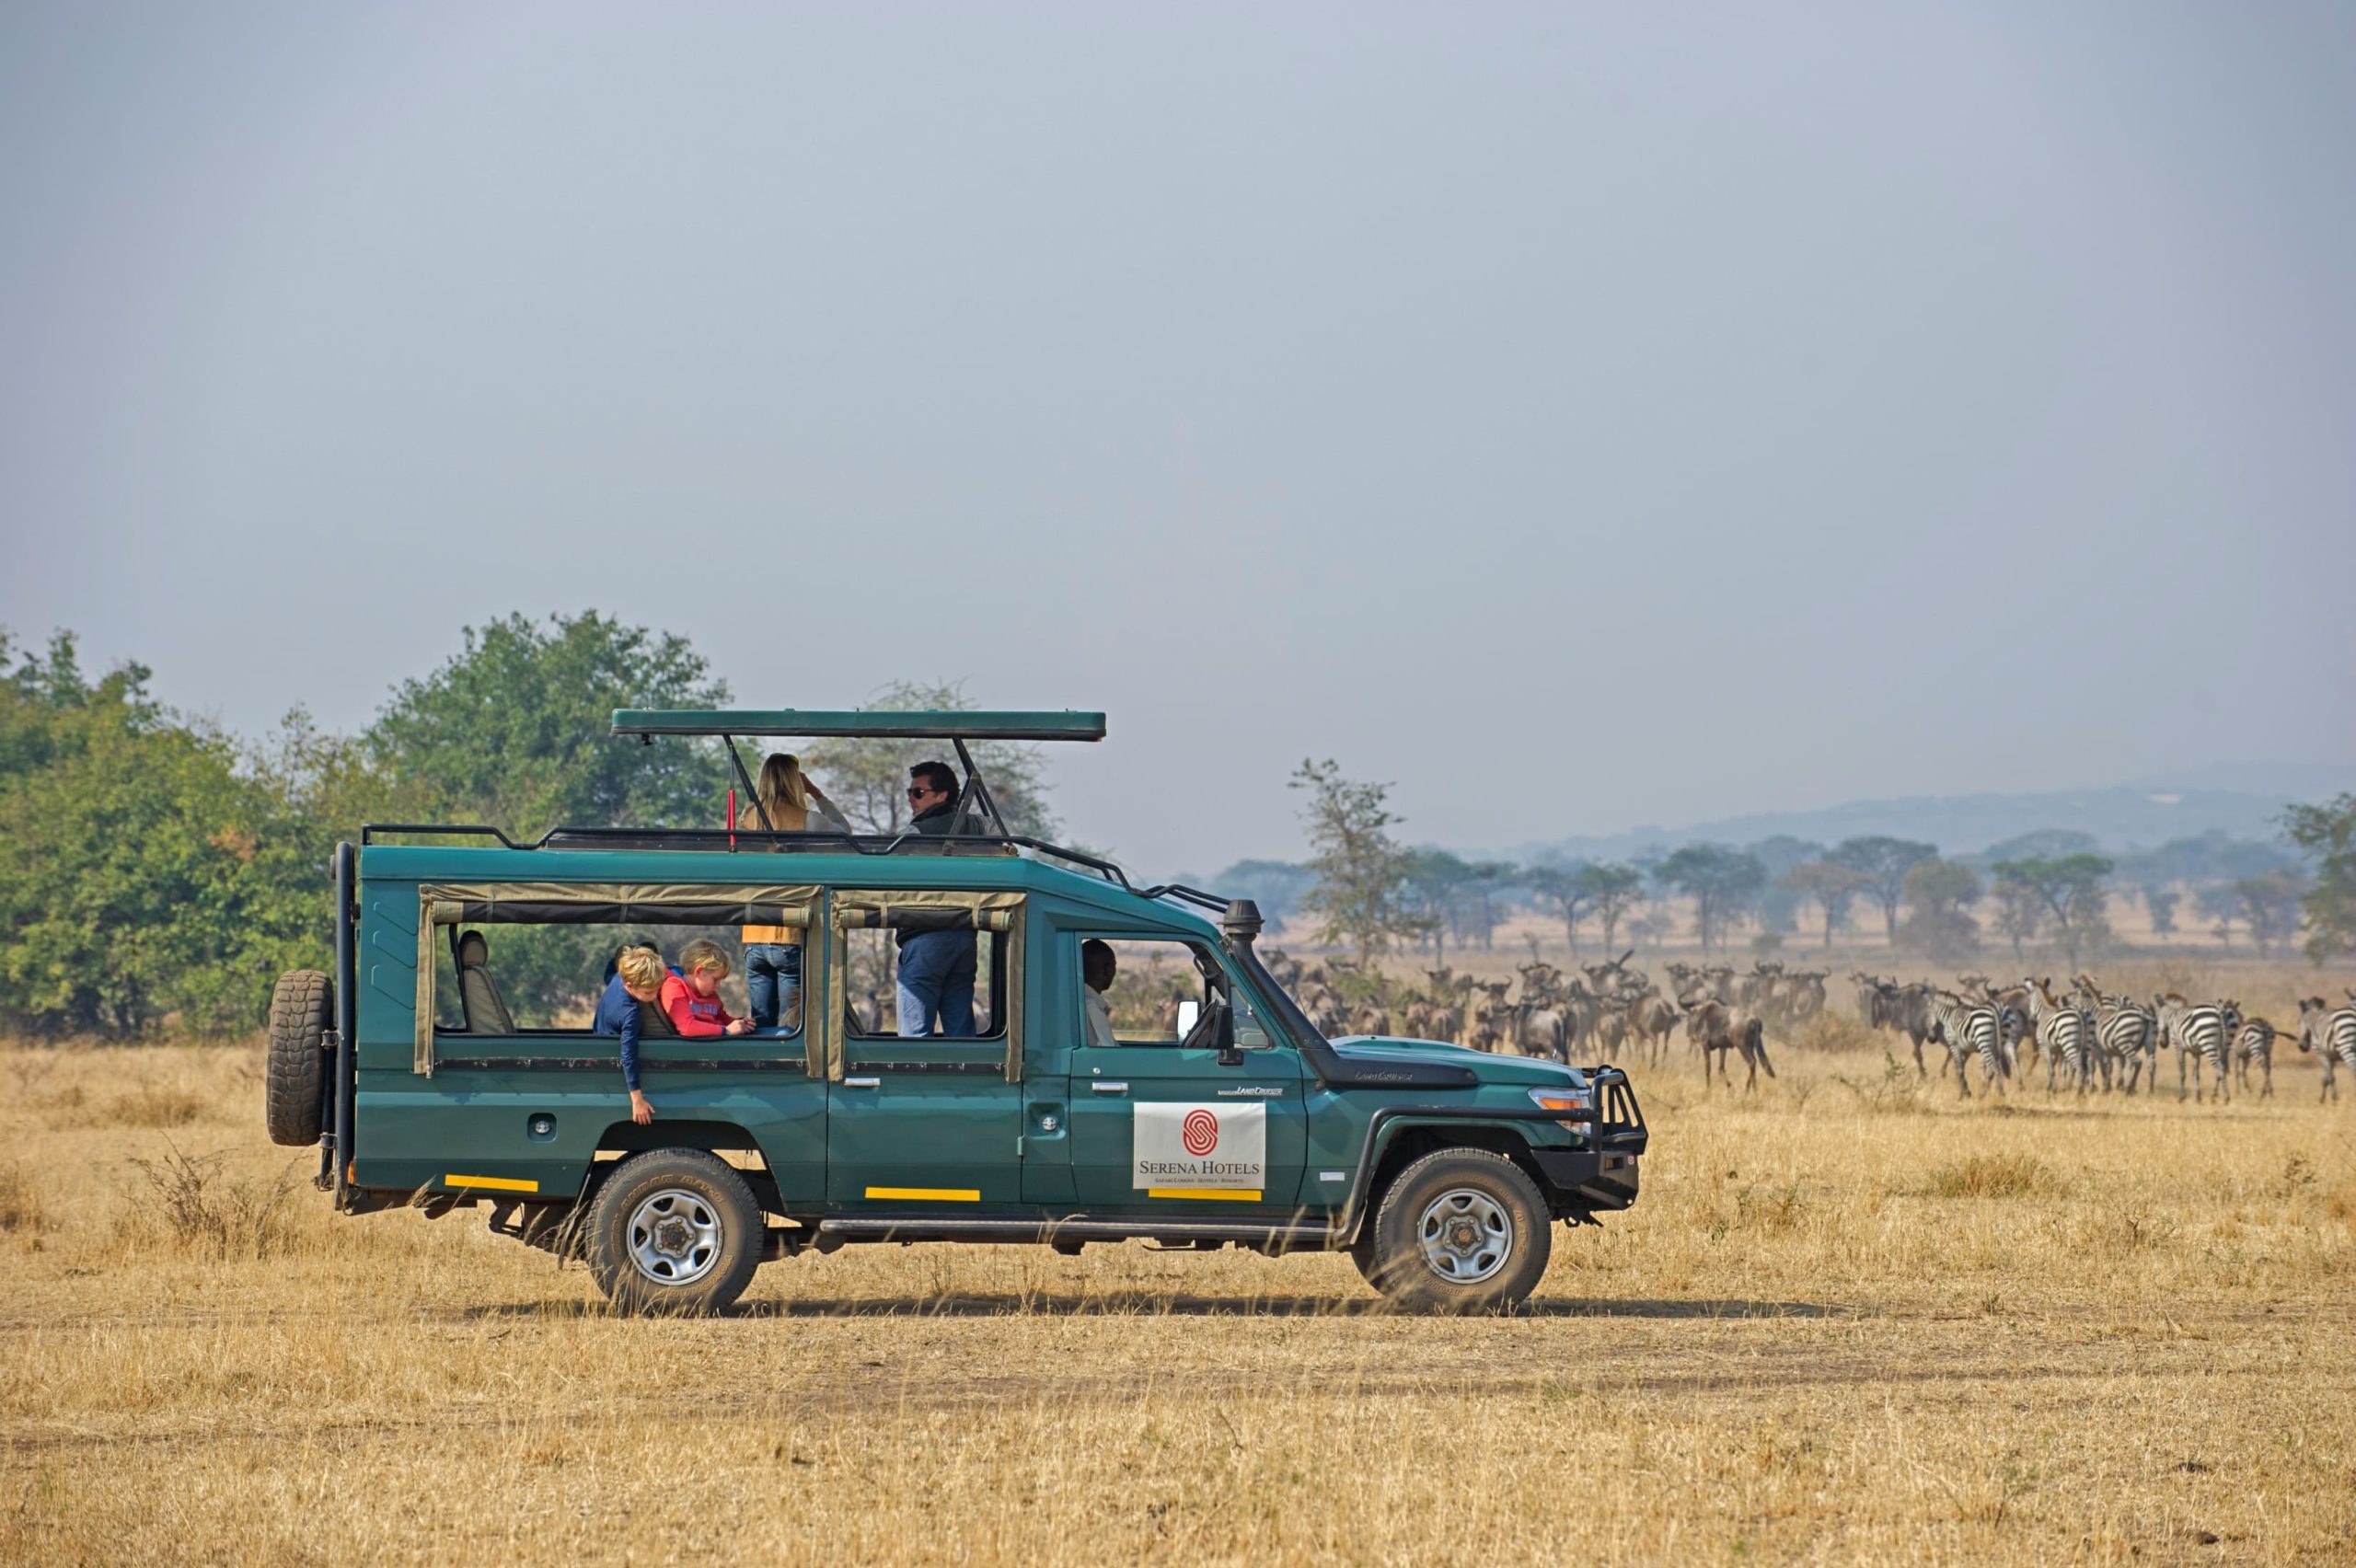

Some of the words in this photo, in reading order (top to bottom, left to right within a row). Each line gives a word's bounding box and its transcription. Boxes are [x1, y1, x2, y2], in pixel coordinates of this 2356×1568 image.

[1237, 1086, 1255, 1096] LAND
[1254, 1087, 1283, 1096] CRUISER
[1140, 1160, 1196, 1174] SERENA
[1202, 1160, 1260, 1174] HOTELS
